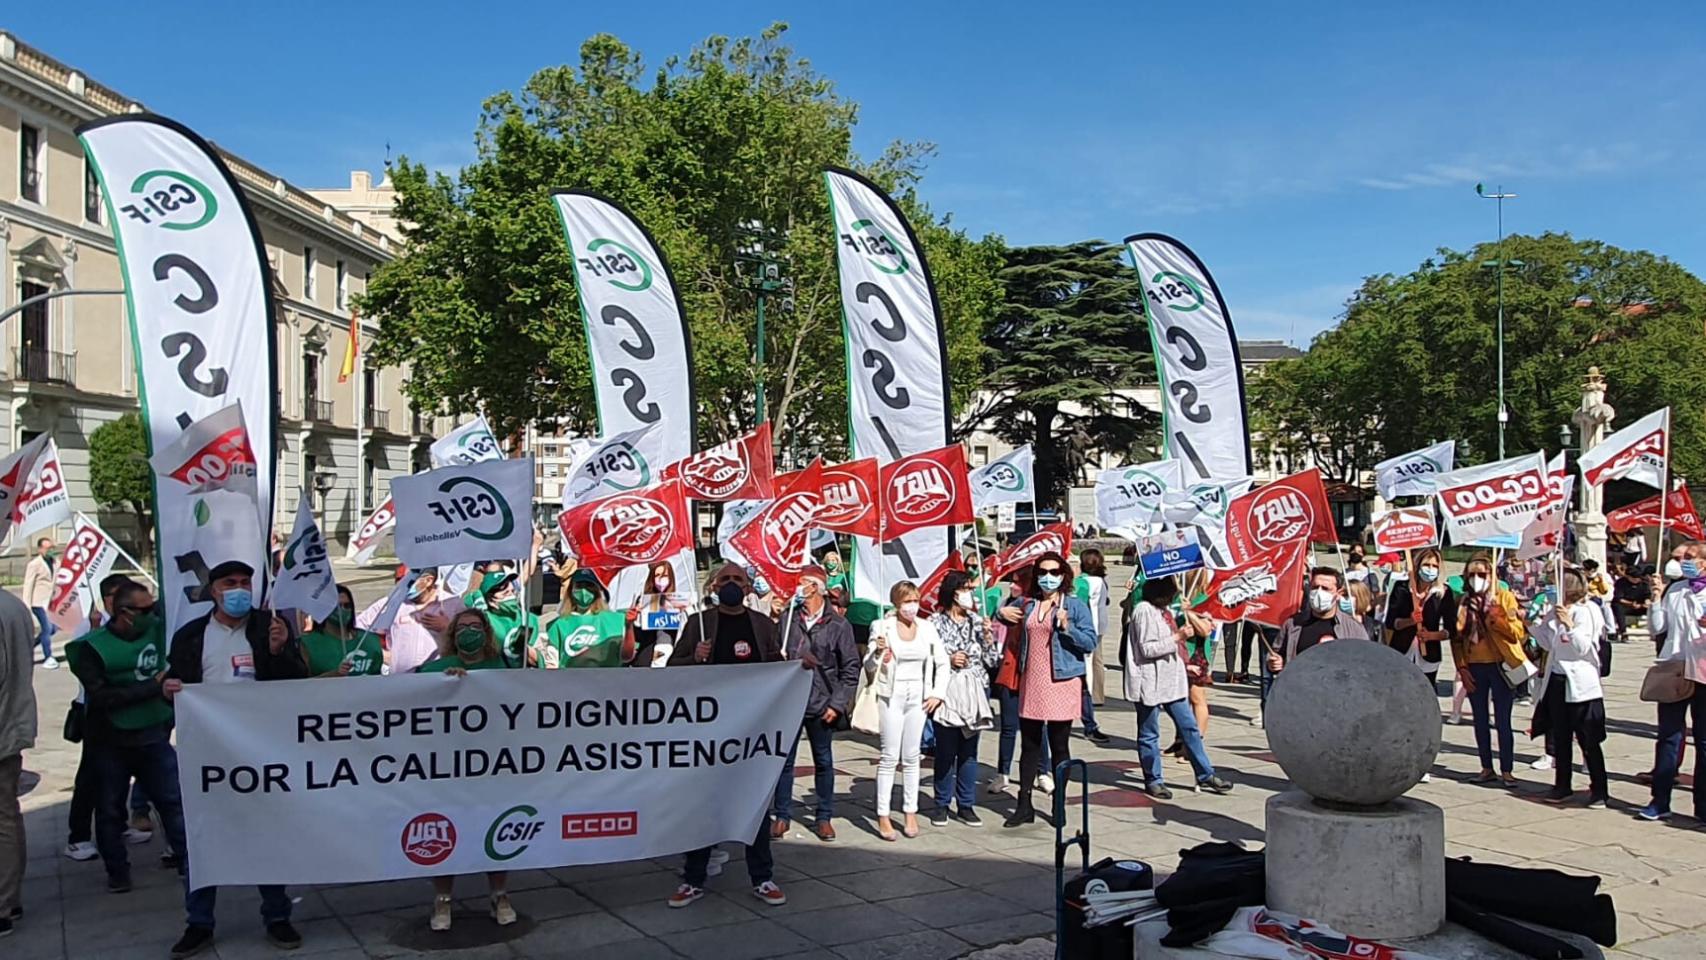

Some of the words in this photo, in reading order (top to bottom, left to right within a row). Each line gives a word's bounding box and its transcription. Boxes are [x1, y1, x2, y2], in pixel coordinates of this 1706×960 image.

[1162, 551, 1180, 562] NO
[297, 704, 488, 743] RESPETO
[500, 703, 526, 731] Y
[537, 696, 719, 729] DIGNIDAD
[201, 763, 292, 794] POR
[306, 757, 359, 790] LA
[370, 746, 545, 784] CALIDAD
[556, 731, 788, 772] ASISTENCIAL
[406, 820, 450, 844] UGT
[496, 821, 545, 842] CSIF
[566, 817, 634, 835] CCOO
